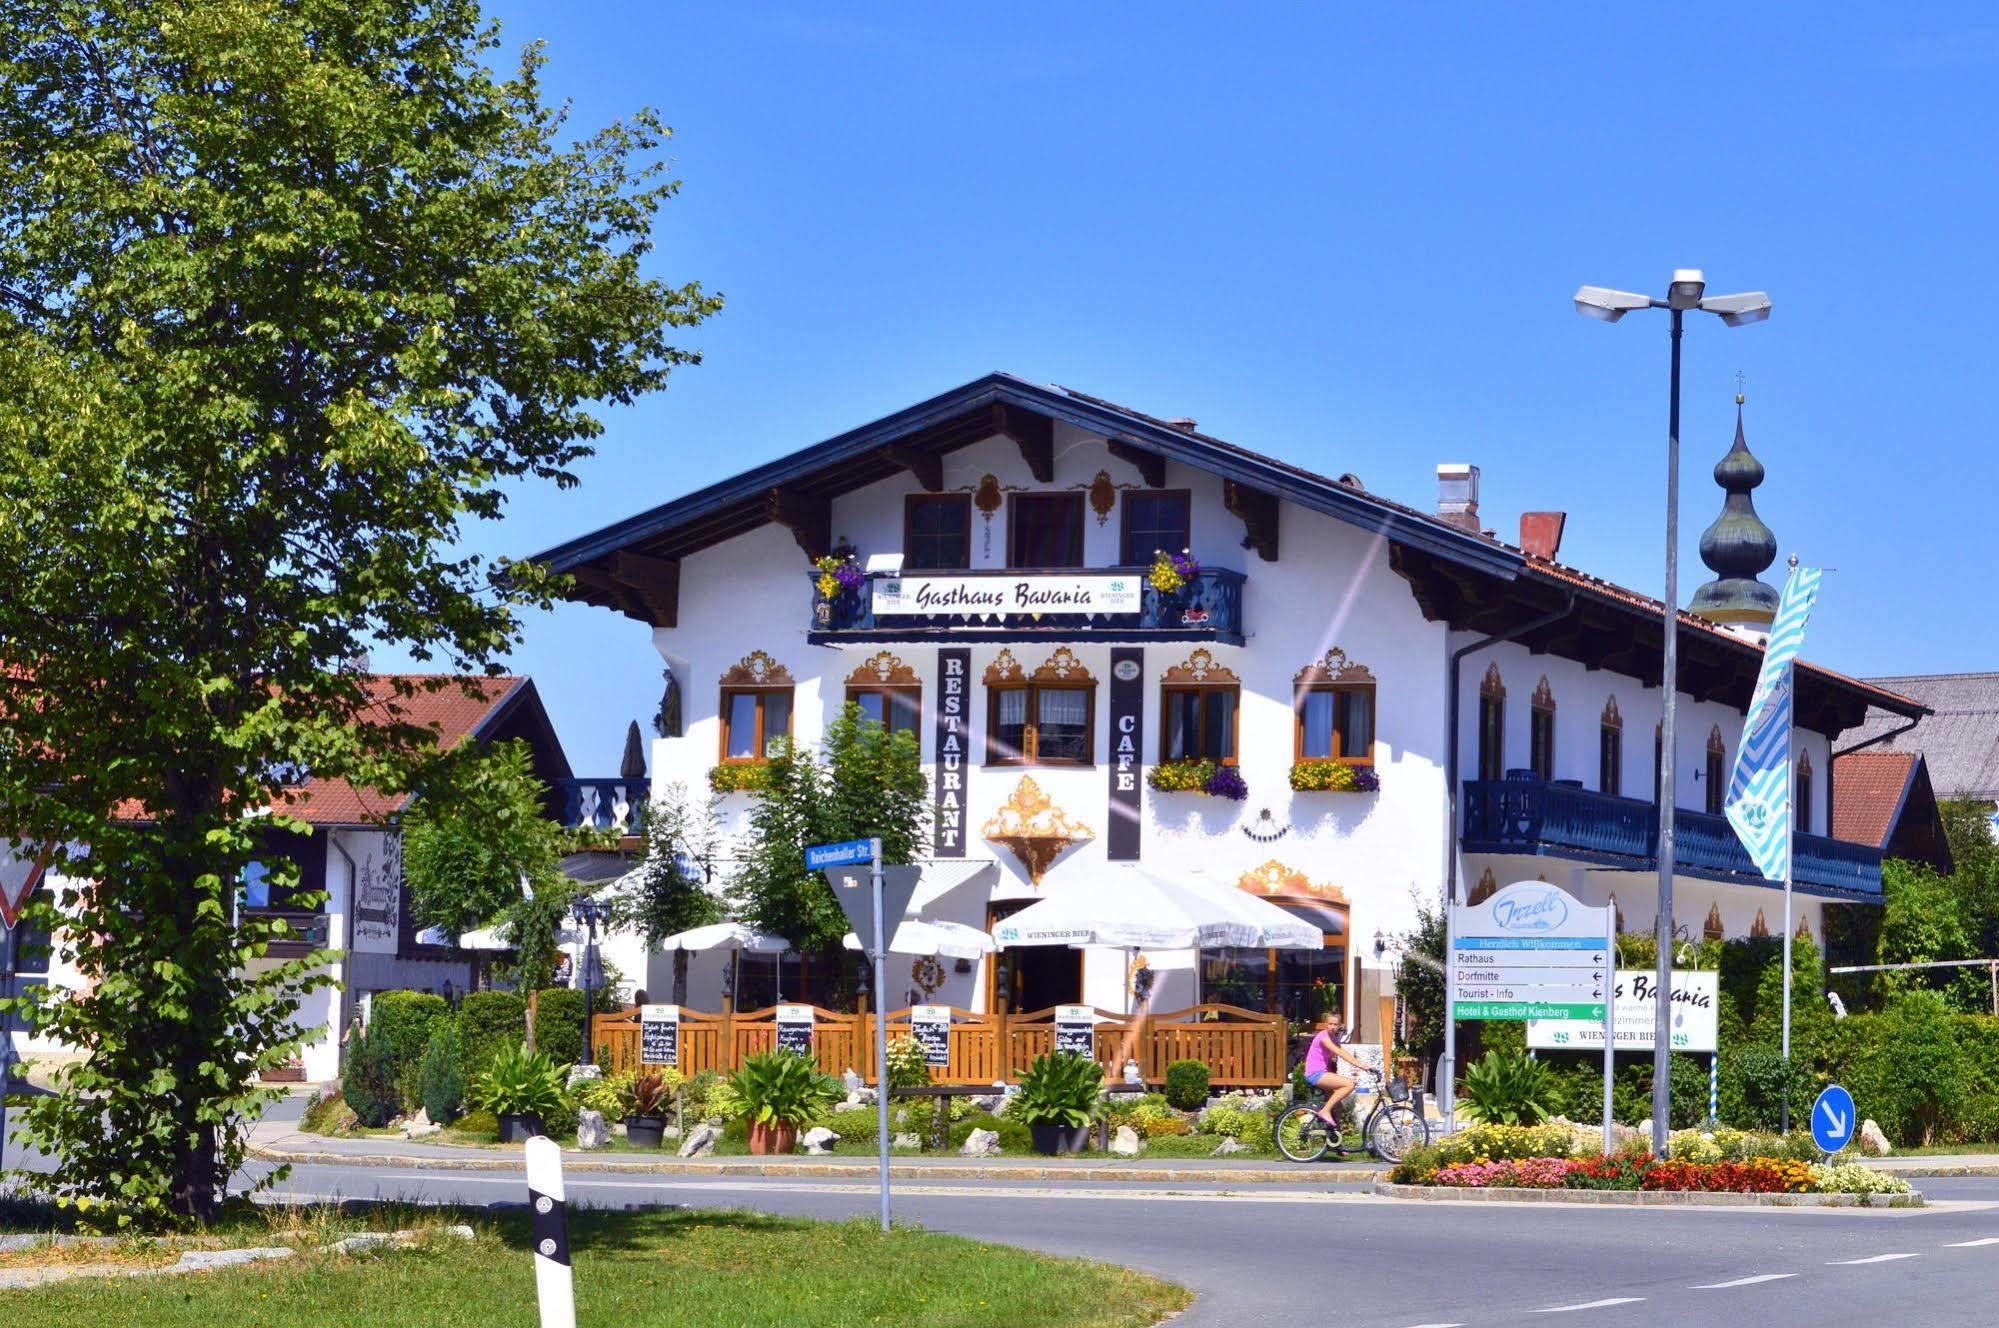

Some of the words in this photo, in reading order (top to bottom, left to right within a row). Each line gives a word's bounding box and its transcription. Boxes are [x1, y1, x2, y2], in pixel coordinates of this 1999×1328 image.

[915, 582, 1004, 609] Gasthaus
[1014, 582, 1092, 608] Bavaria
[942, 658, 963, 847] RESTAURANT
[1116, 715, 1135, 791] CAFE
[810, 846, 855, 865] Reichenhaller
[856, 844, 870, 859] Str.
[1027, 930, 1071, 939] WIENINGER
[1072, 930, 1089, 938] BIER
[1480, 940, 1518, 949] Herzlich
[1457, 953, 1494, 964] Rathaus
[1457, 971, 1500, 981] Dorfmitte
[1457, 988, 1489, 999] Tourist
[1496, 988, 1514, 999] Info
[1633, 975, 1710, 1009] Baaria
[1457, 1006, 1480, 1016] Hotel
[1482, 1006, 1490, 1016] &
[1491, 1005, 1527, 1016] Gasthof
[1529, 1006, 1569, 1019] Kienberg
[1579, 1031, 1636, 1041] WIENNGER
[1639, 1032, 1656, 1041] BIE
